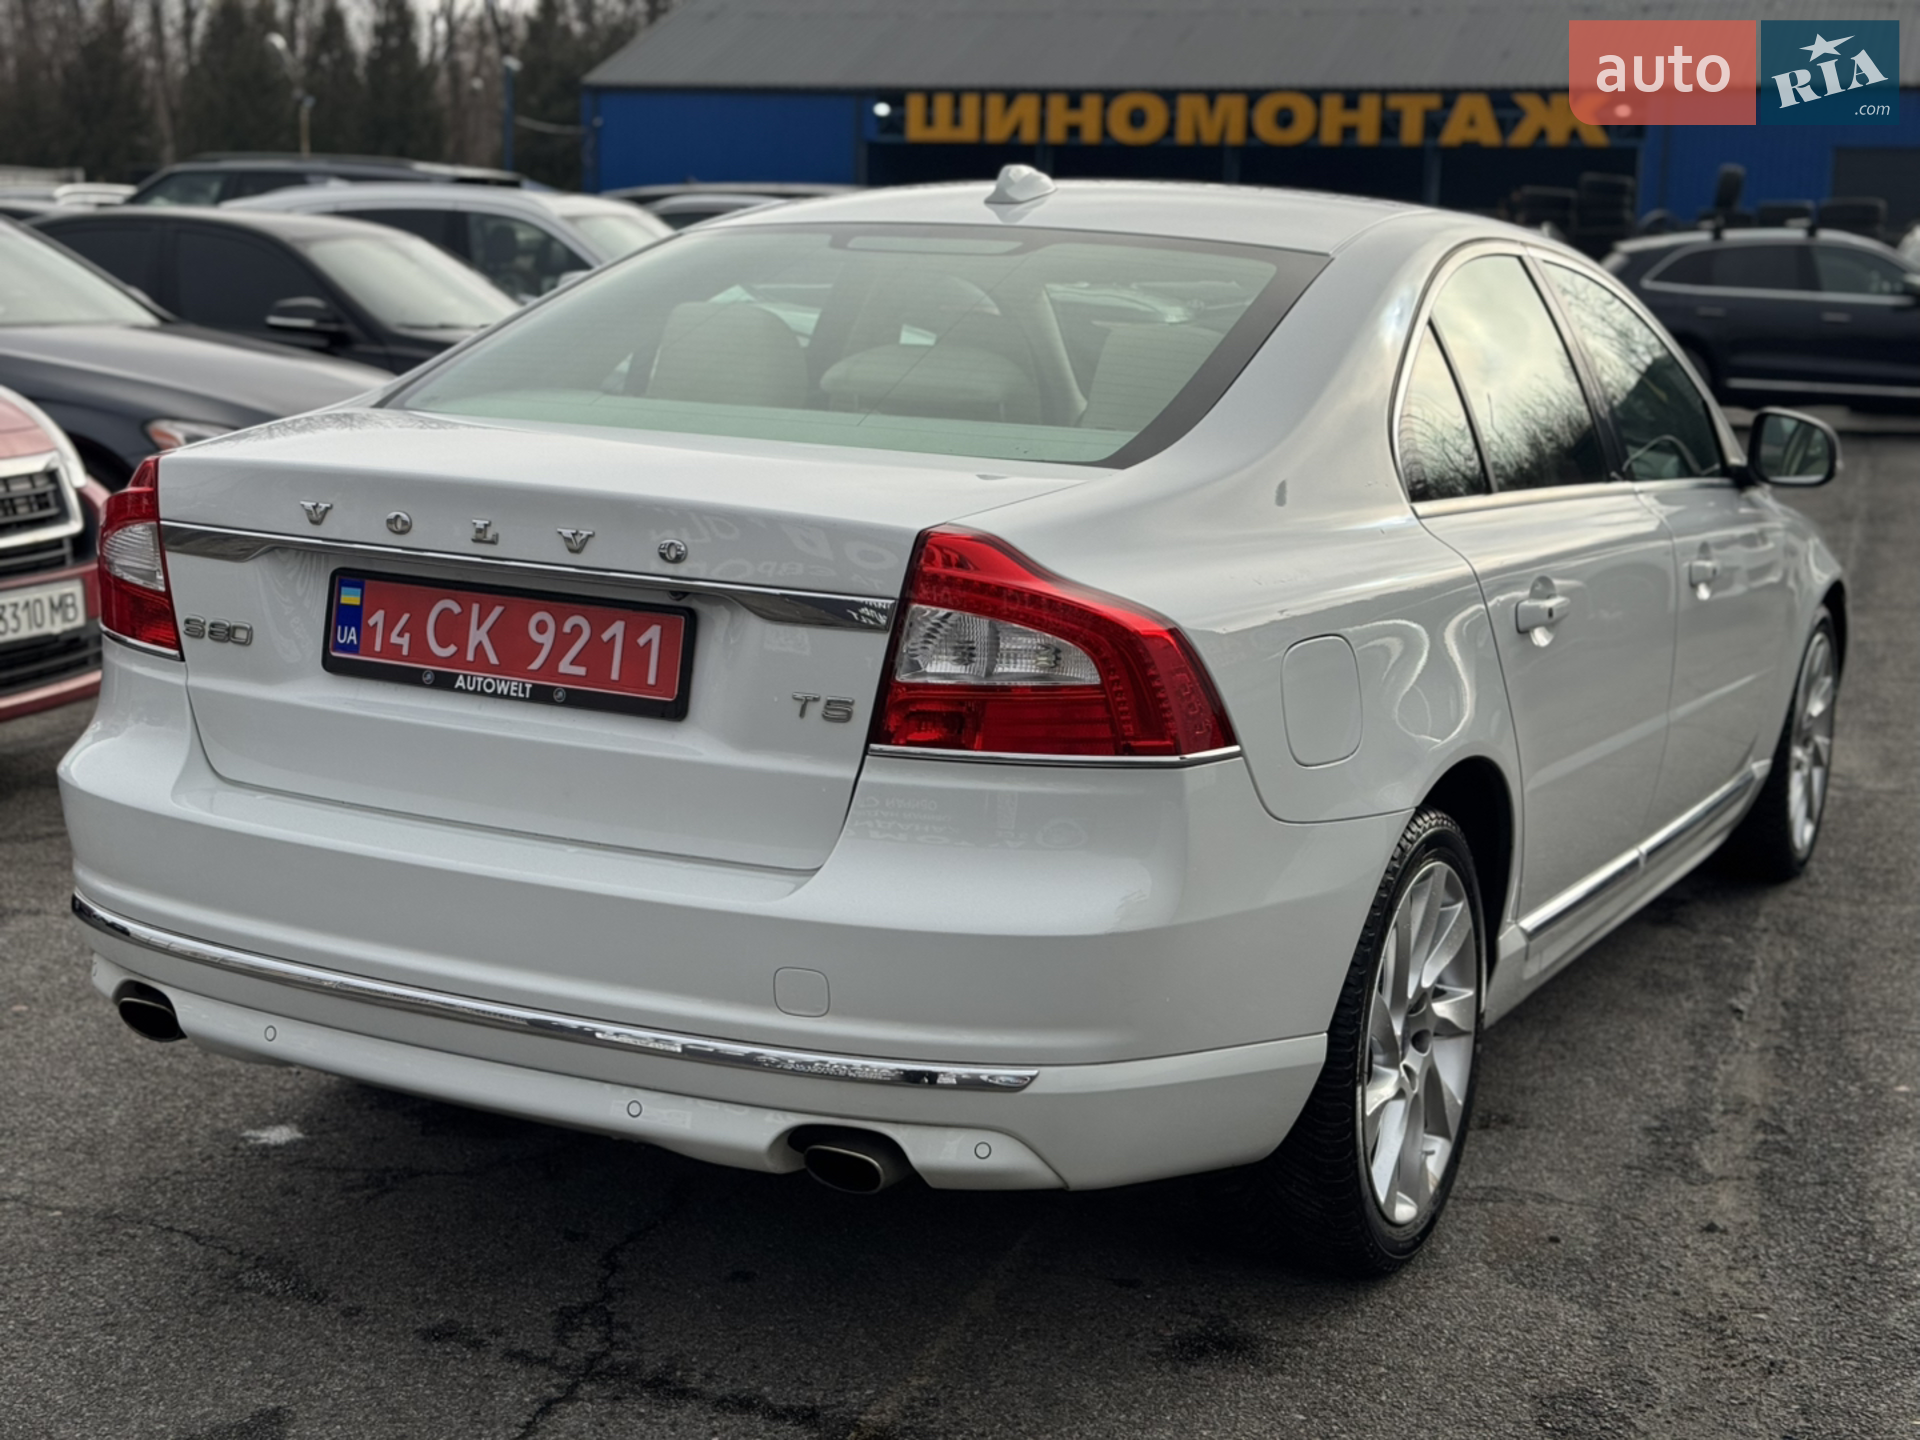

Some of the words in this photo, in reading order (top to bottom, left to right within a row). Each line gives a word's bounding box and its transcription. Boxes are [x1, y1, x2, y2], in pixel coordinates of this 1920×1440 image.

[904, 92, 1610, 148] ШИНОМОНТАЖ
[300, 500, 688, 563] VOLVO
[183, 613, 253, 646] S80
[336, 625, 358, 646] UA
[367, 609, 410, 656] 14
[426, 598, 506, 666] CK
[527, 611, 662, 686] 9211
[454, 674, 533, 699] AUTOWELT
[792, 692, 856, 723] T5
